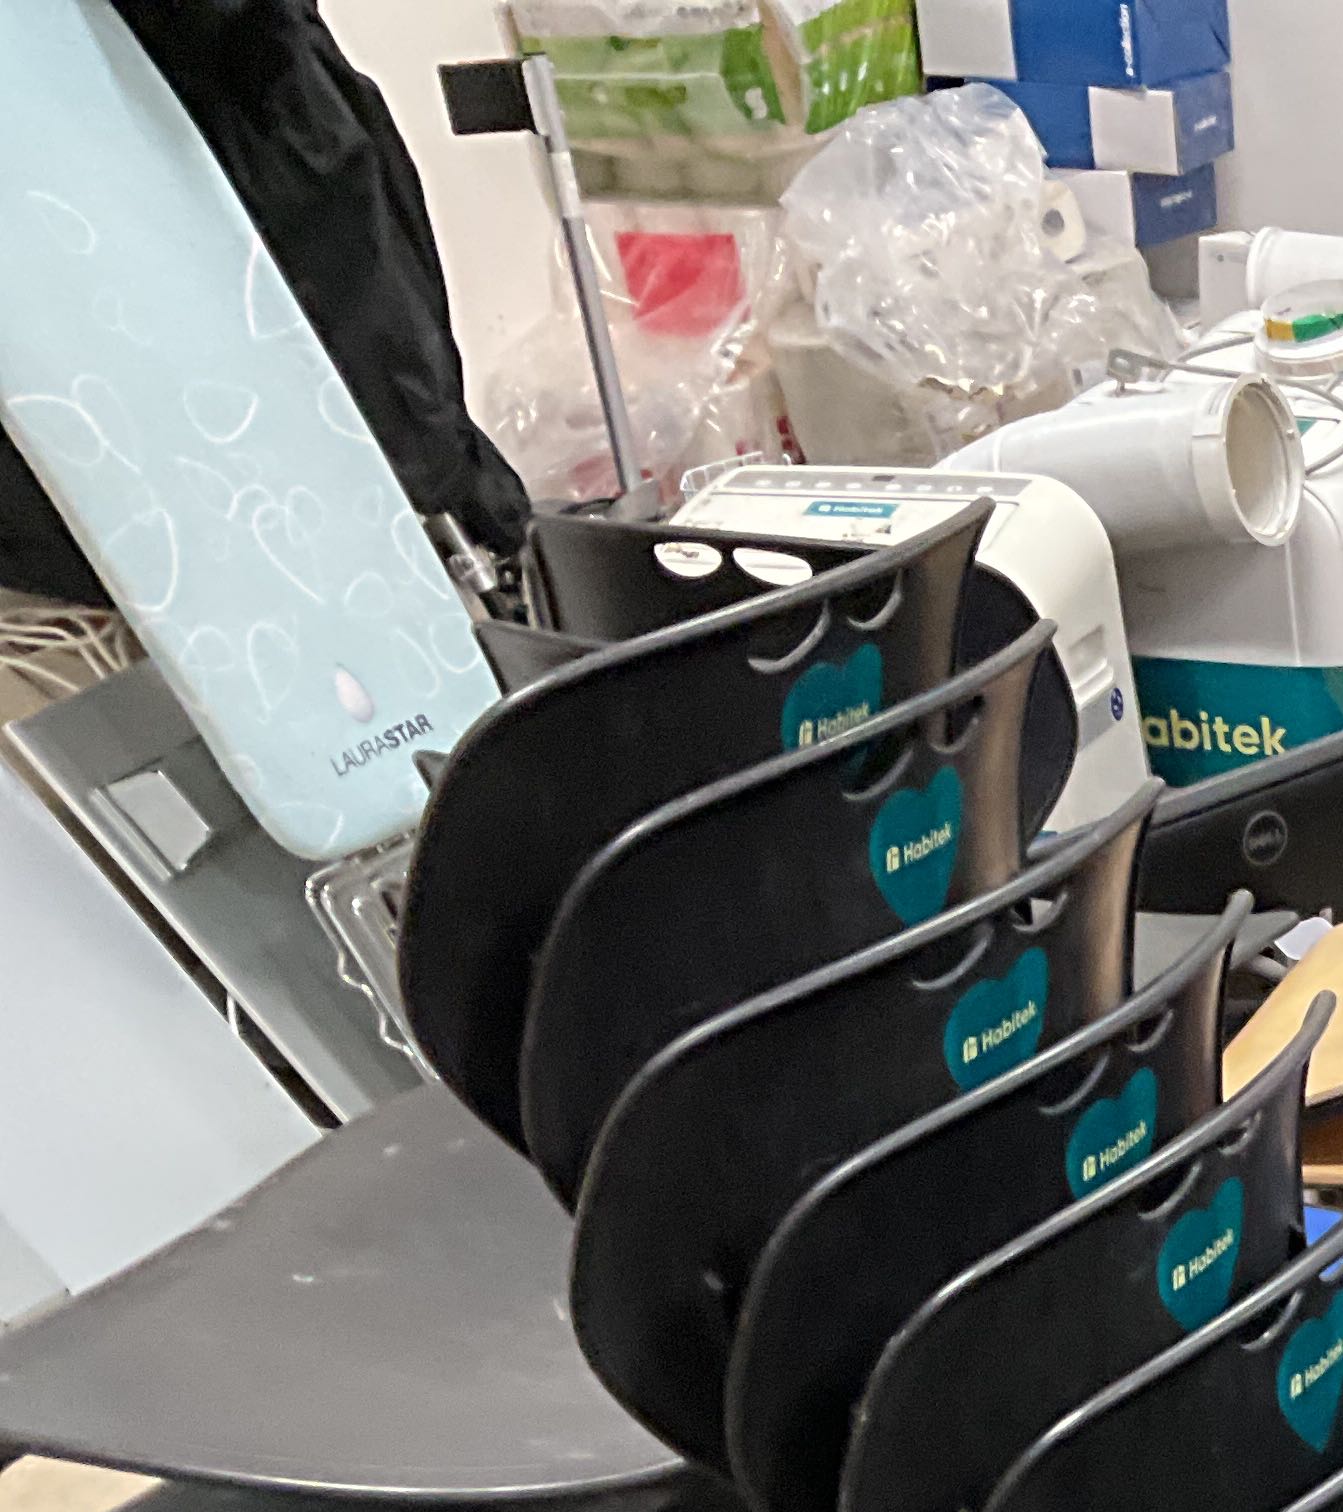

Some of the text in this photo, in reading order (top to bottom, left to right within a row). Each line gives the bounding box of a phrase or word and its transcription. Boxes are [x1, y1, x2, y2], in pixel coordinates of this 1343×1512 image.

[329, 713, 434, 777] LAURASTAR
[1143, 708, 1287, 756] abitek
[903, 820, 953, 865] Habitek
[981, 999, 1038, 1054] Habitek
[1099, 1119, 1148, 1171] Habitek
[1188, 1227, 1235, 1281] Habitek
